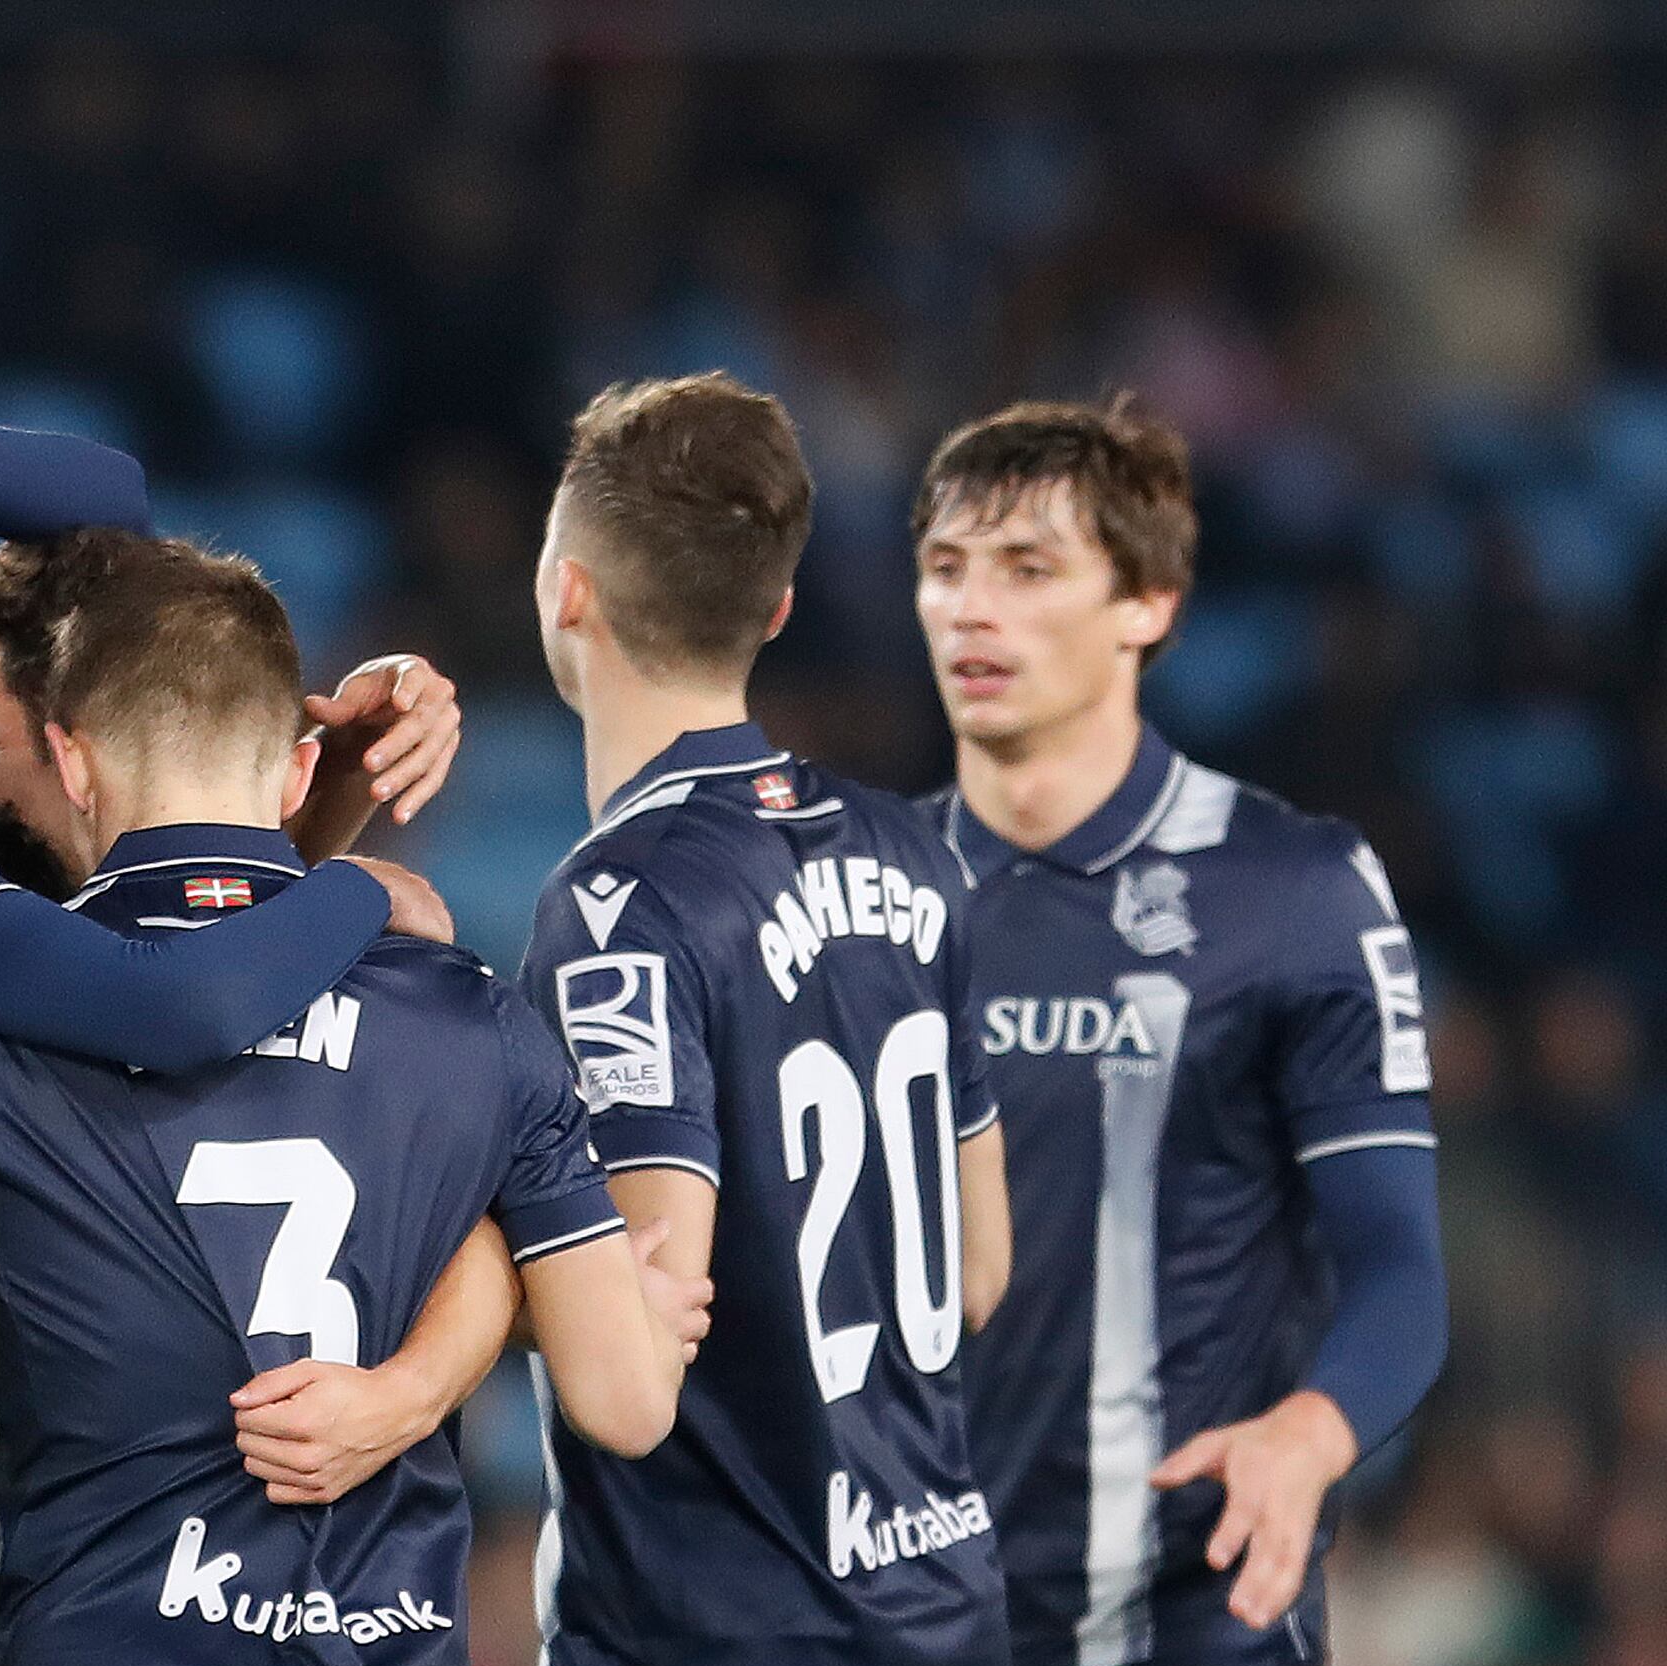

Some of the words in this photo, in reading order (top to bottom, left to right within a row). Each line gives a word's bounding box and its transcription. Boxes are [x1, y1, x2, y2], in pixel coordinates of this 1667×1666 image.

[759, 857, 947, 1004] PAHECO
[980, 995, 1154, 1056] SUDA
[175, 1137, 360, 1368] 3
[778, 1009, 964, 1404] 20
[157, 1516, 454, 1645] Kutaank
